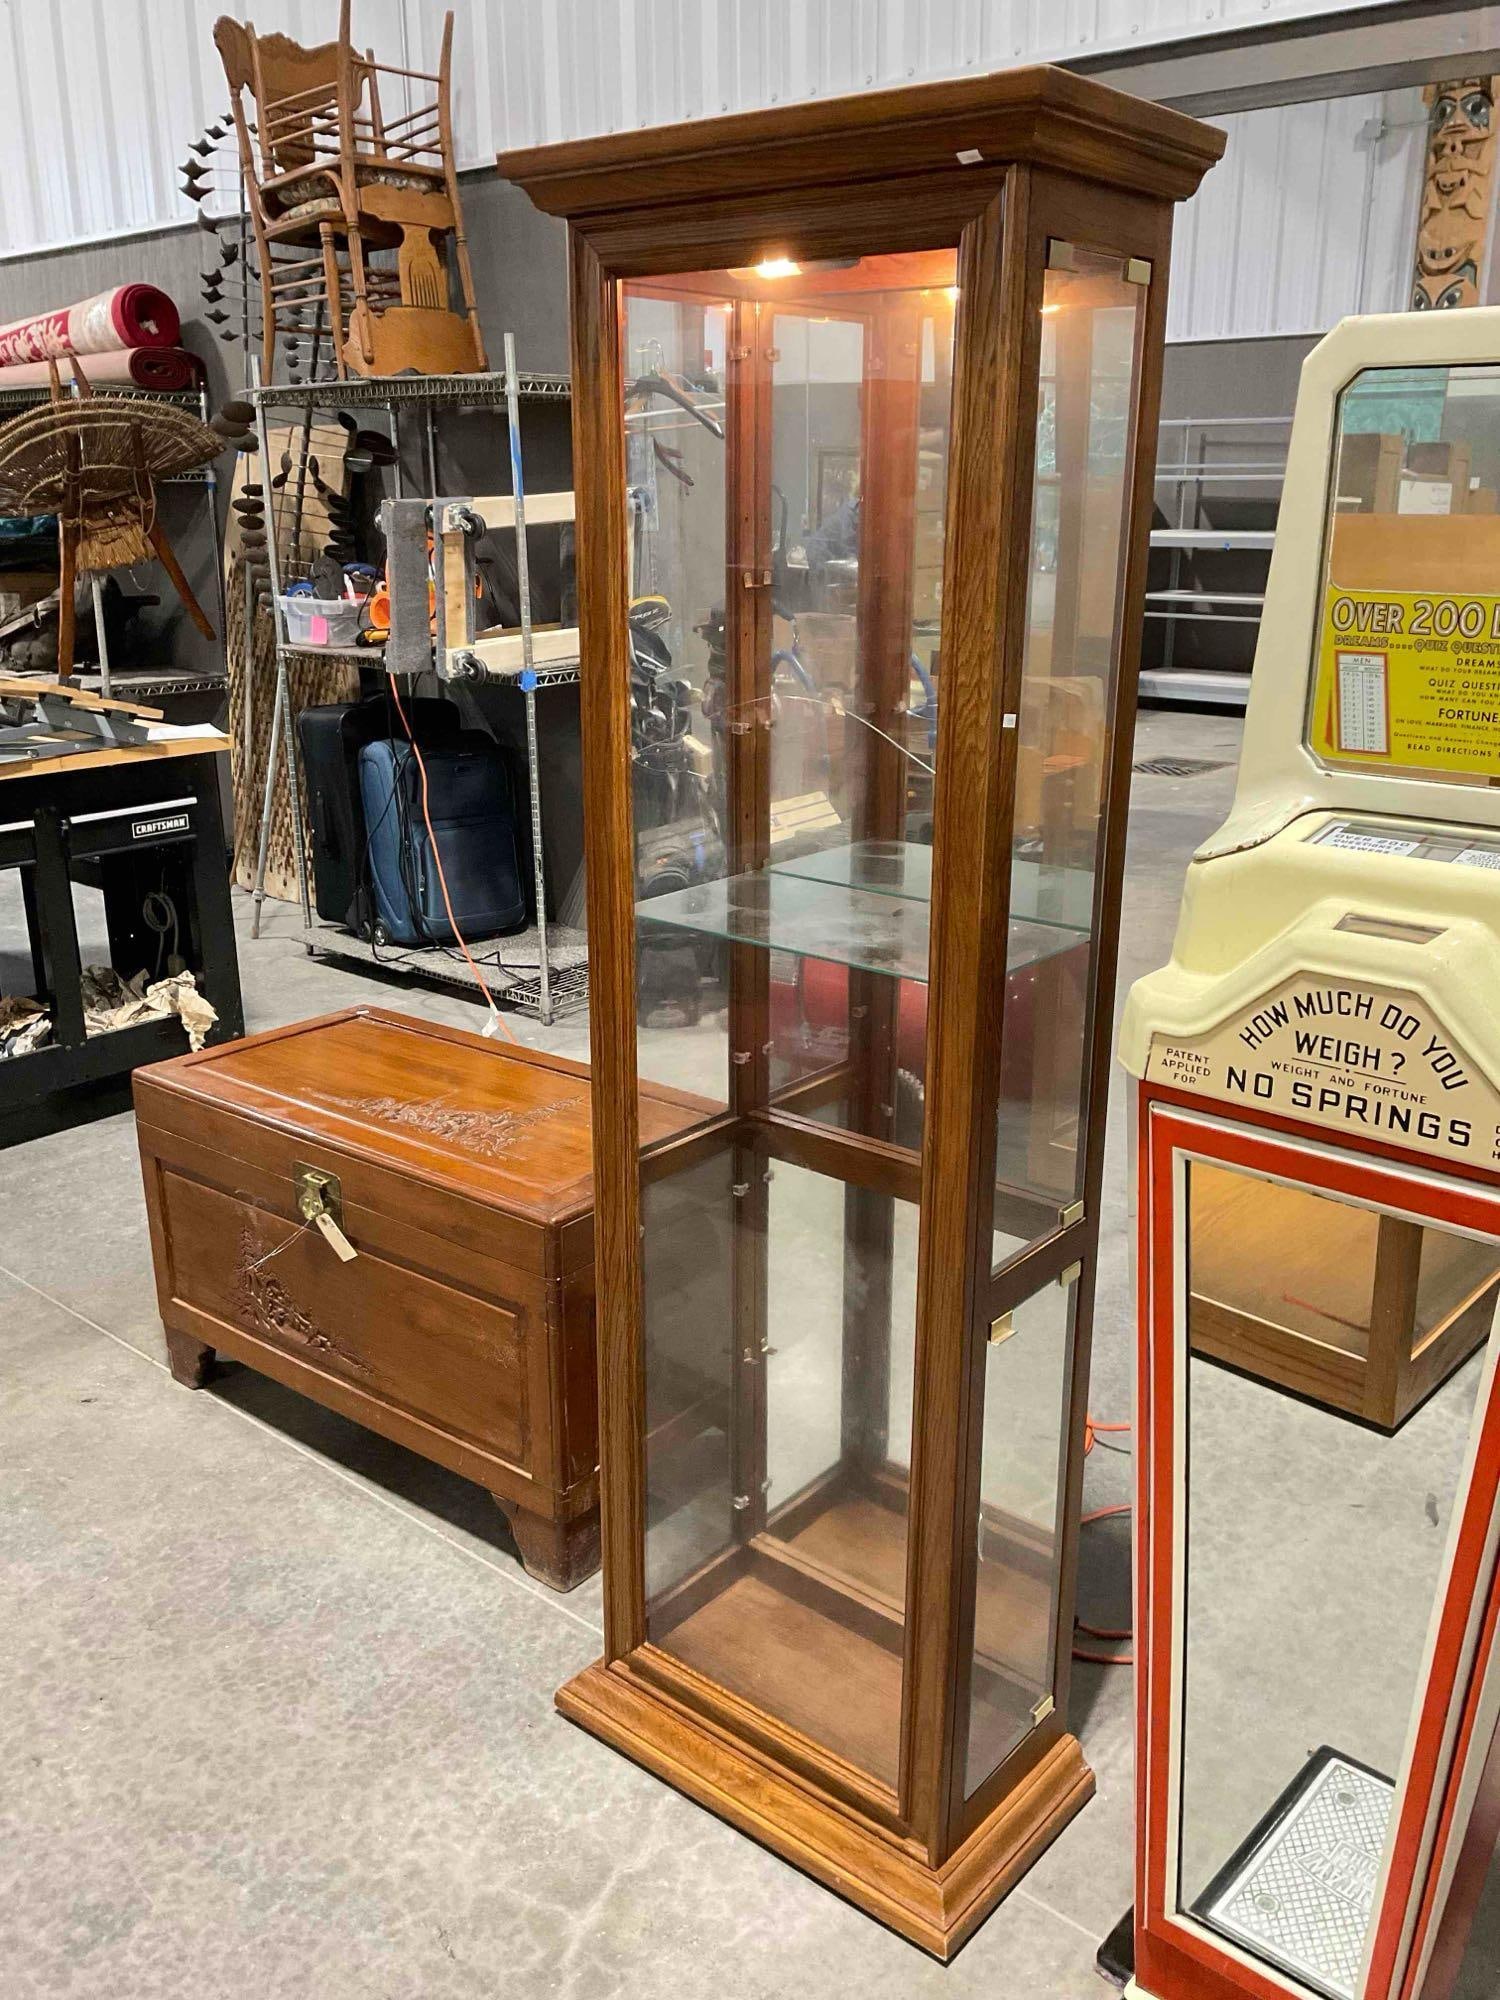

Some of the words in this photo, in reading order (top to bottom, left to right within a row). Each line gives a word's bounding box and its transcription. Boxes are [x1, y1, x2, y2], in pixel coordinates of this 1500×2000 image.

[1332, 596, 1404, 634] OVER
[1408, 599, 1486, 638] 200
[1414, 638, 1448, 653] QUIZ
[1428, 678, 1455, 688] QUIZ
[1438, 708, 1500, 723] FORTUNE
[1407, 743, 1431, 751] READ
[1436, 745, 1492, 757] DIRECTIONS
[135, 817, 186, 835] CRAFTSMAN
[1335, 833, 1372, 842] OVER
[1238, 1000, 1290, 1051] HOW
[1293, 990, 1374, 1020] MUCH
[1379, 1003, 1421, 1041] DO
[1421, 1034, 1469, 1090] YOU
[1166, 1047, 1210, 1065] PATENT
[1161, 1058, 1212, 1077] APPLIED
[1173, 1072, 1197, 1085] FOR
[1271, 1060, 1320, 1079] WEIGHT
[1329, 1074, 1355, 1088] AND
[1364, 1082, 1428, 1105] FORTUNE
[1226, 1065, 1274, 1099] NO
[1291, 1081, 1472, 1147] SPRINGS
